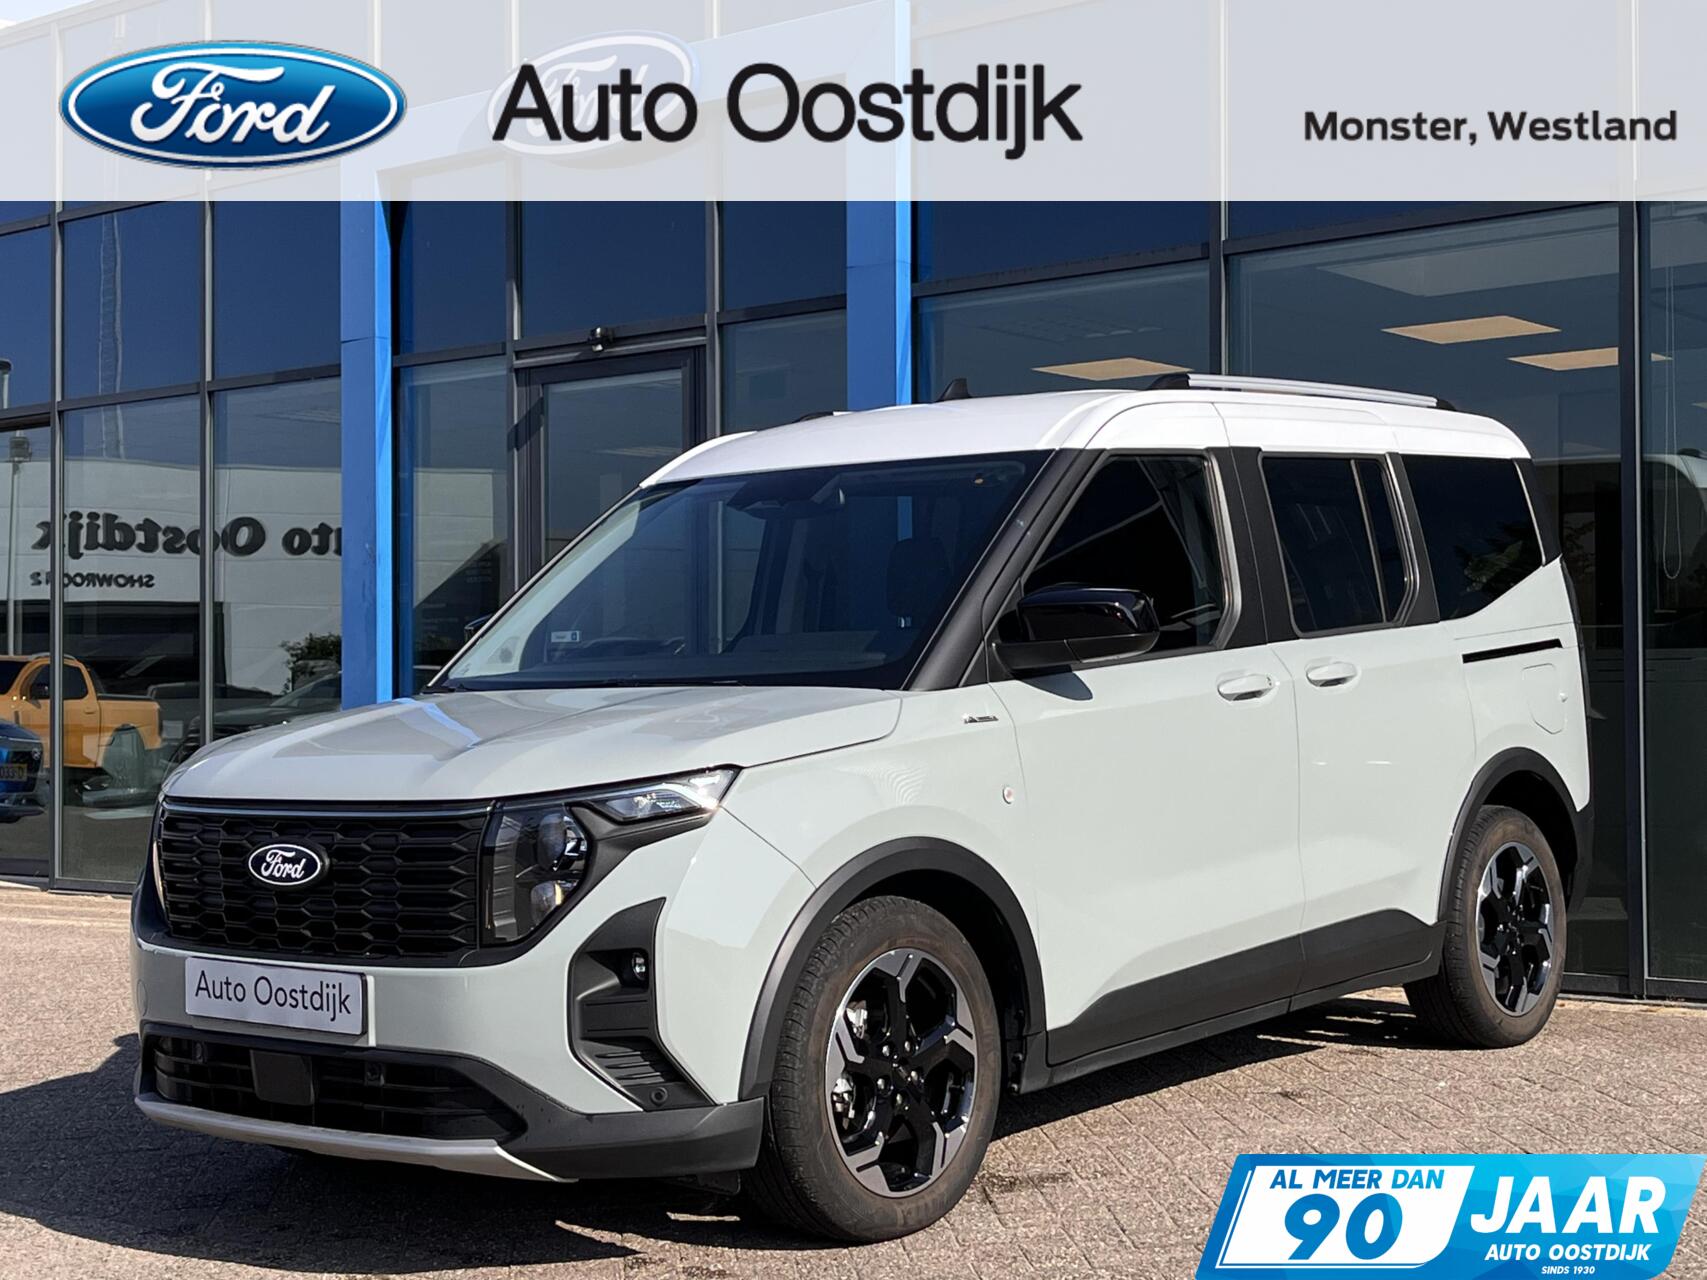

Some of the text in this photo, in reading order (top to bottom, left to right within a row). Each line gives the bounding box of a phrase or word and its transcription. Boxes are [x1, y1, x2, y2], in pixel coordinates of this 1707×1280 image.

[261, 849, 306, 879] Ford
[195, 970, 351, 1022] Auto Oostdijk
